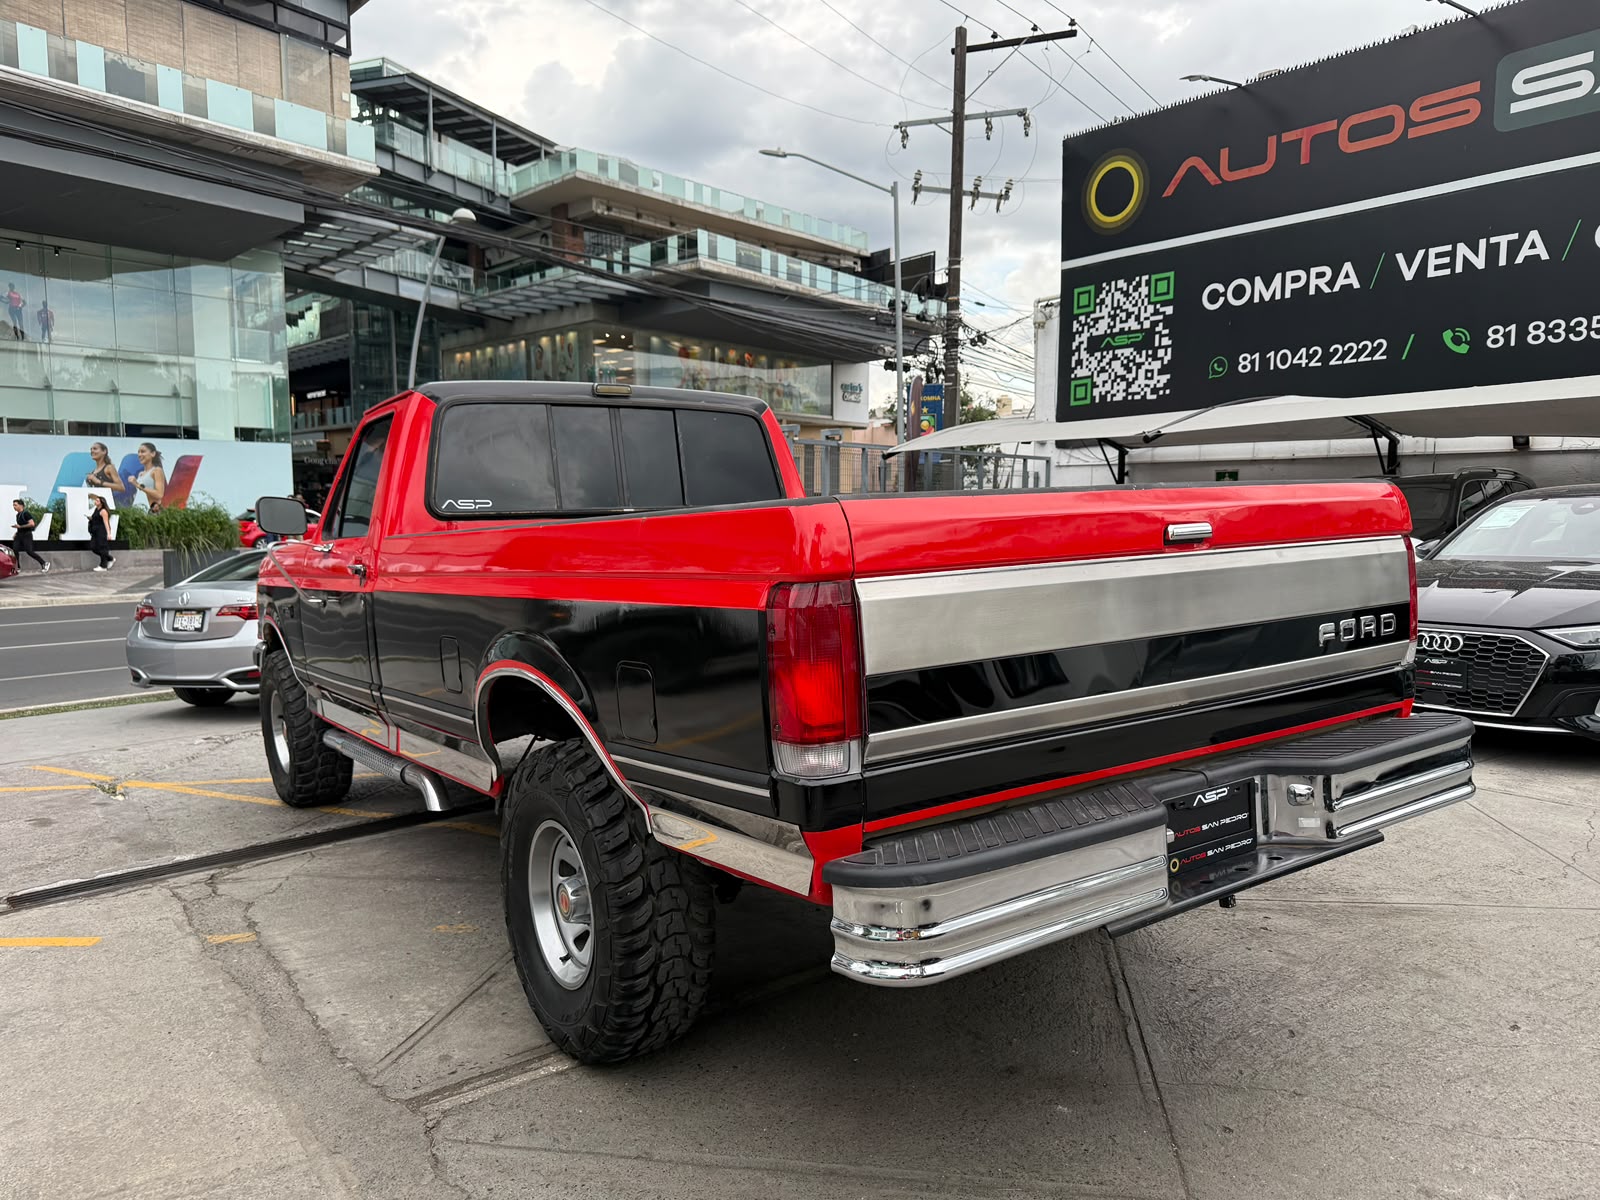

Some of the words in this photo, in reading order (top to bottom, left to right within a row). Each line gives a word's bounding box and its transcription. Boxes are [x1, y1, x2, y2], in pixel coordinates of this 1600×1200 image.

[1162, 80, 1482, 198] AUTOS
[1509, 50, 1600, 114] S
[1201, 261, 1361, 311] COMPRA
[1395, 229, 1550, 282] VENTA
[1100, 332, 1145, 348] ASP
[1486, 323, 1517, 349] 81
[1237, 352, 1260, 374] 81
[1265, 346, 1322, 371] 1042
[1328, 338, 1388, 366] 2222
[441, 499, 493, 510] ASP
[1319, 613, 1397, 647] FORD
[1193, 787, 1229, 807] ASP
[1174, 826, 1201, 838] AUTOS
[1201, 821, 1219, 831] SAN
[1220, 813, 1248, 825] PEDRO
[1180, 851, 1207, 865] AUTOS
[1206, 847, 1224, 857] SAN
[1225, 838, 1253, 851] PEDRO
